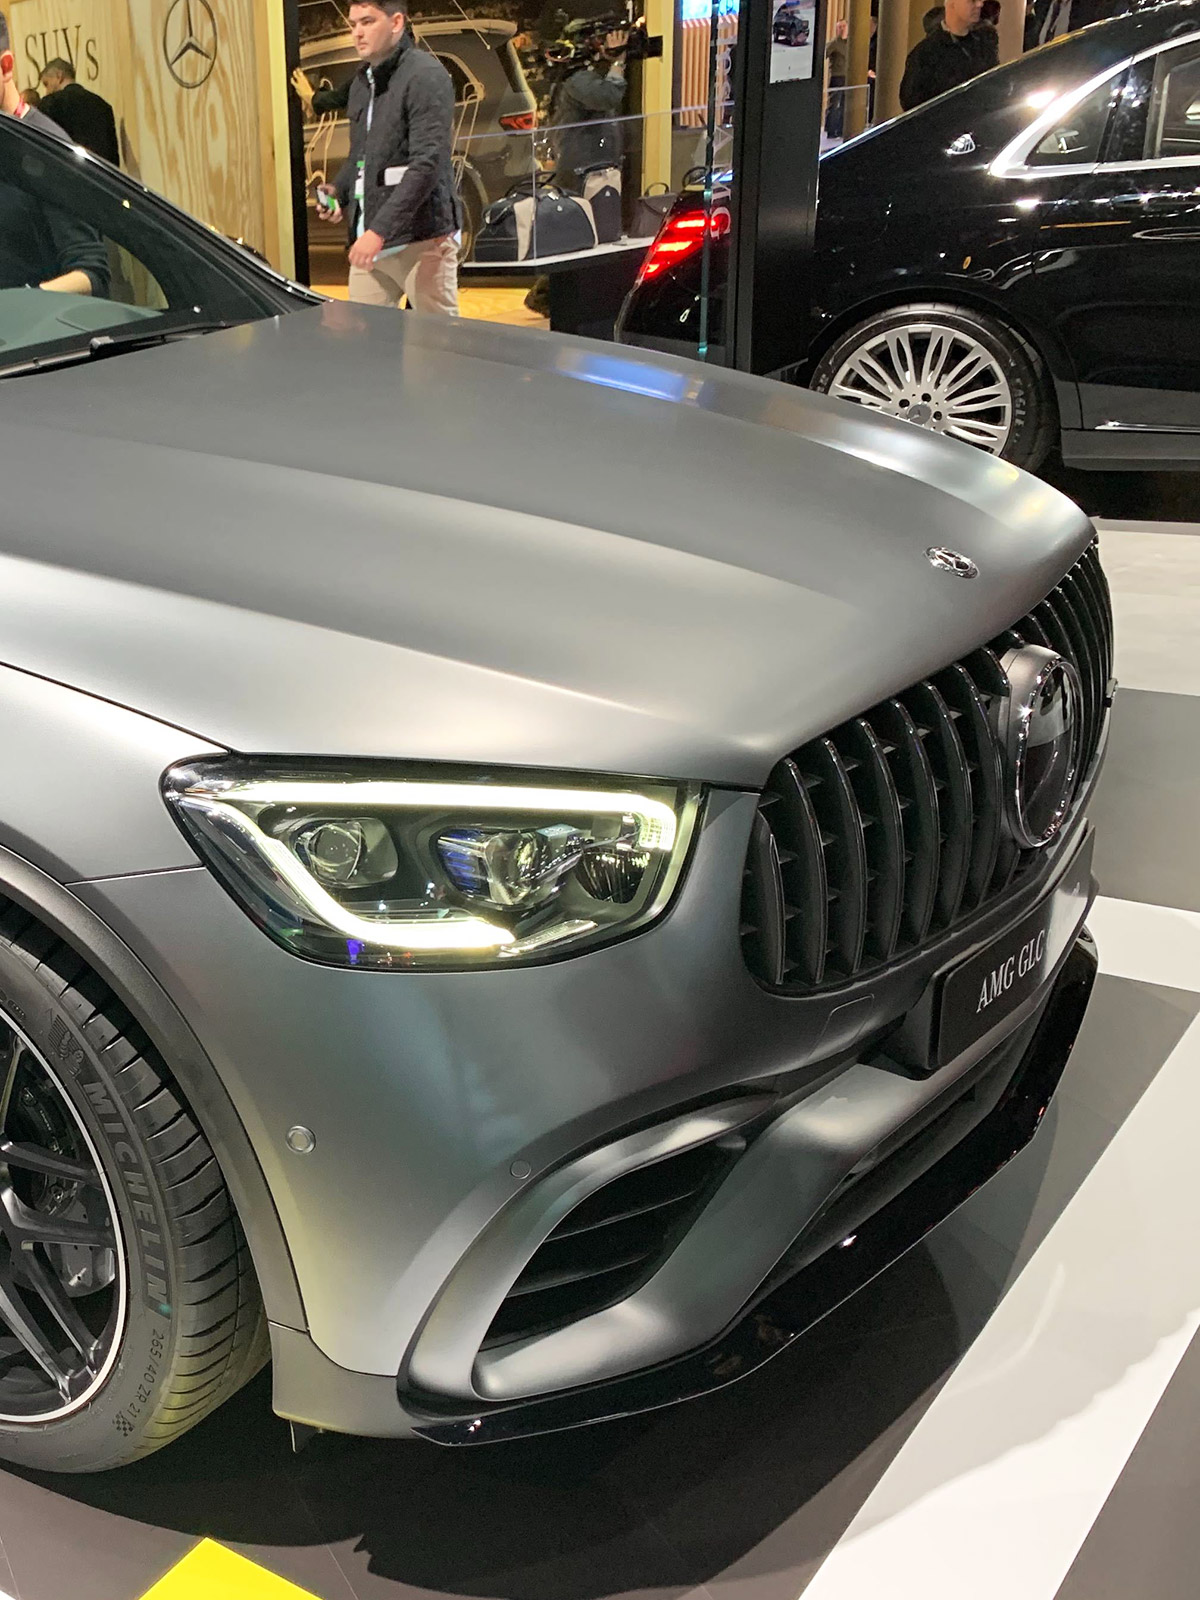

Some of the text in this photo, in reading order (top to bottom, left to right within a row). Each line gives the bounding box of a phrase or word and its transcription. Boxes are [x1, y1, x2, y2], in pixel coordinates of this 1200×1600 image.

[24, 24, 100, 91] SUVs
[976, 929, 1046, 1014] AMG GLC
[82, 1081, 169, 1303] MICHELIN
[126, 1328, 165, 1419] 265/40 ZR 21
